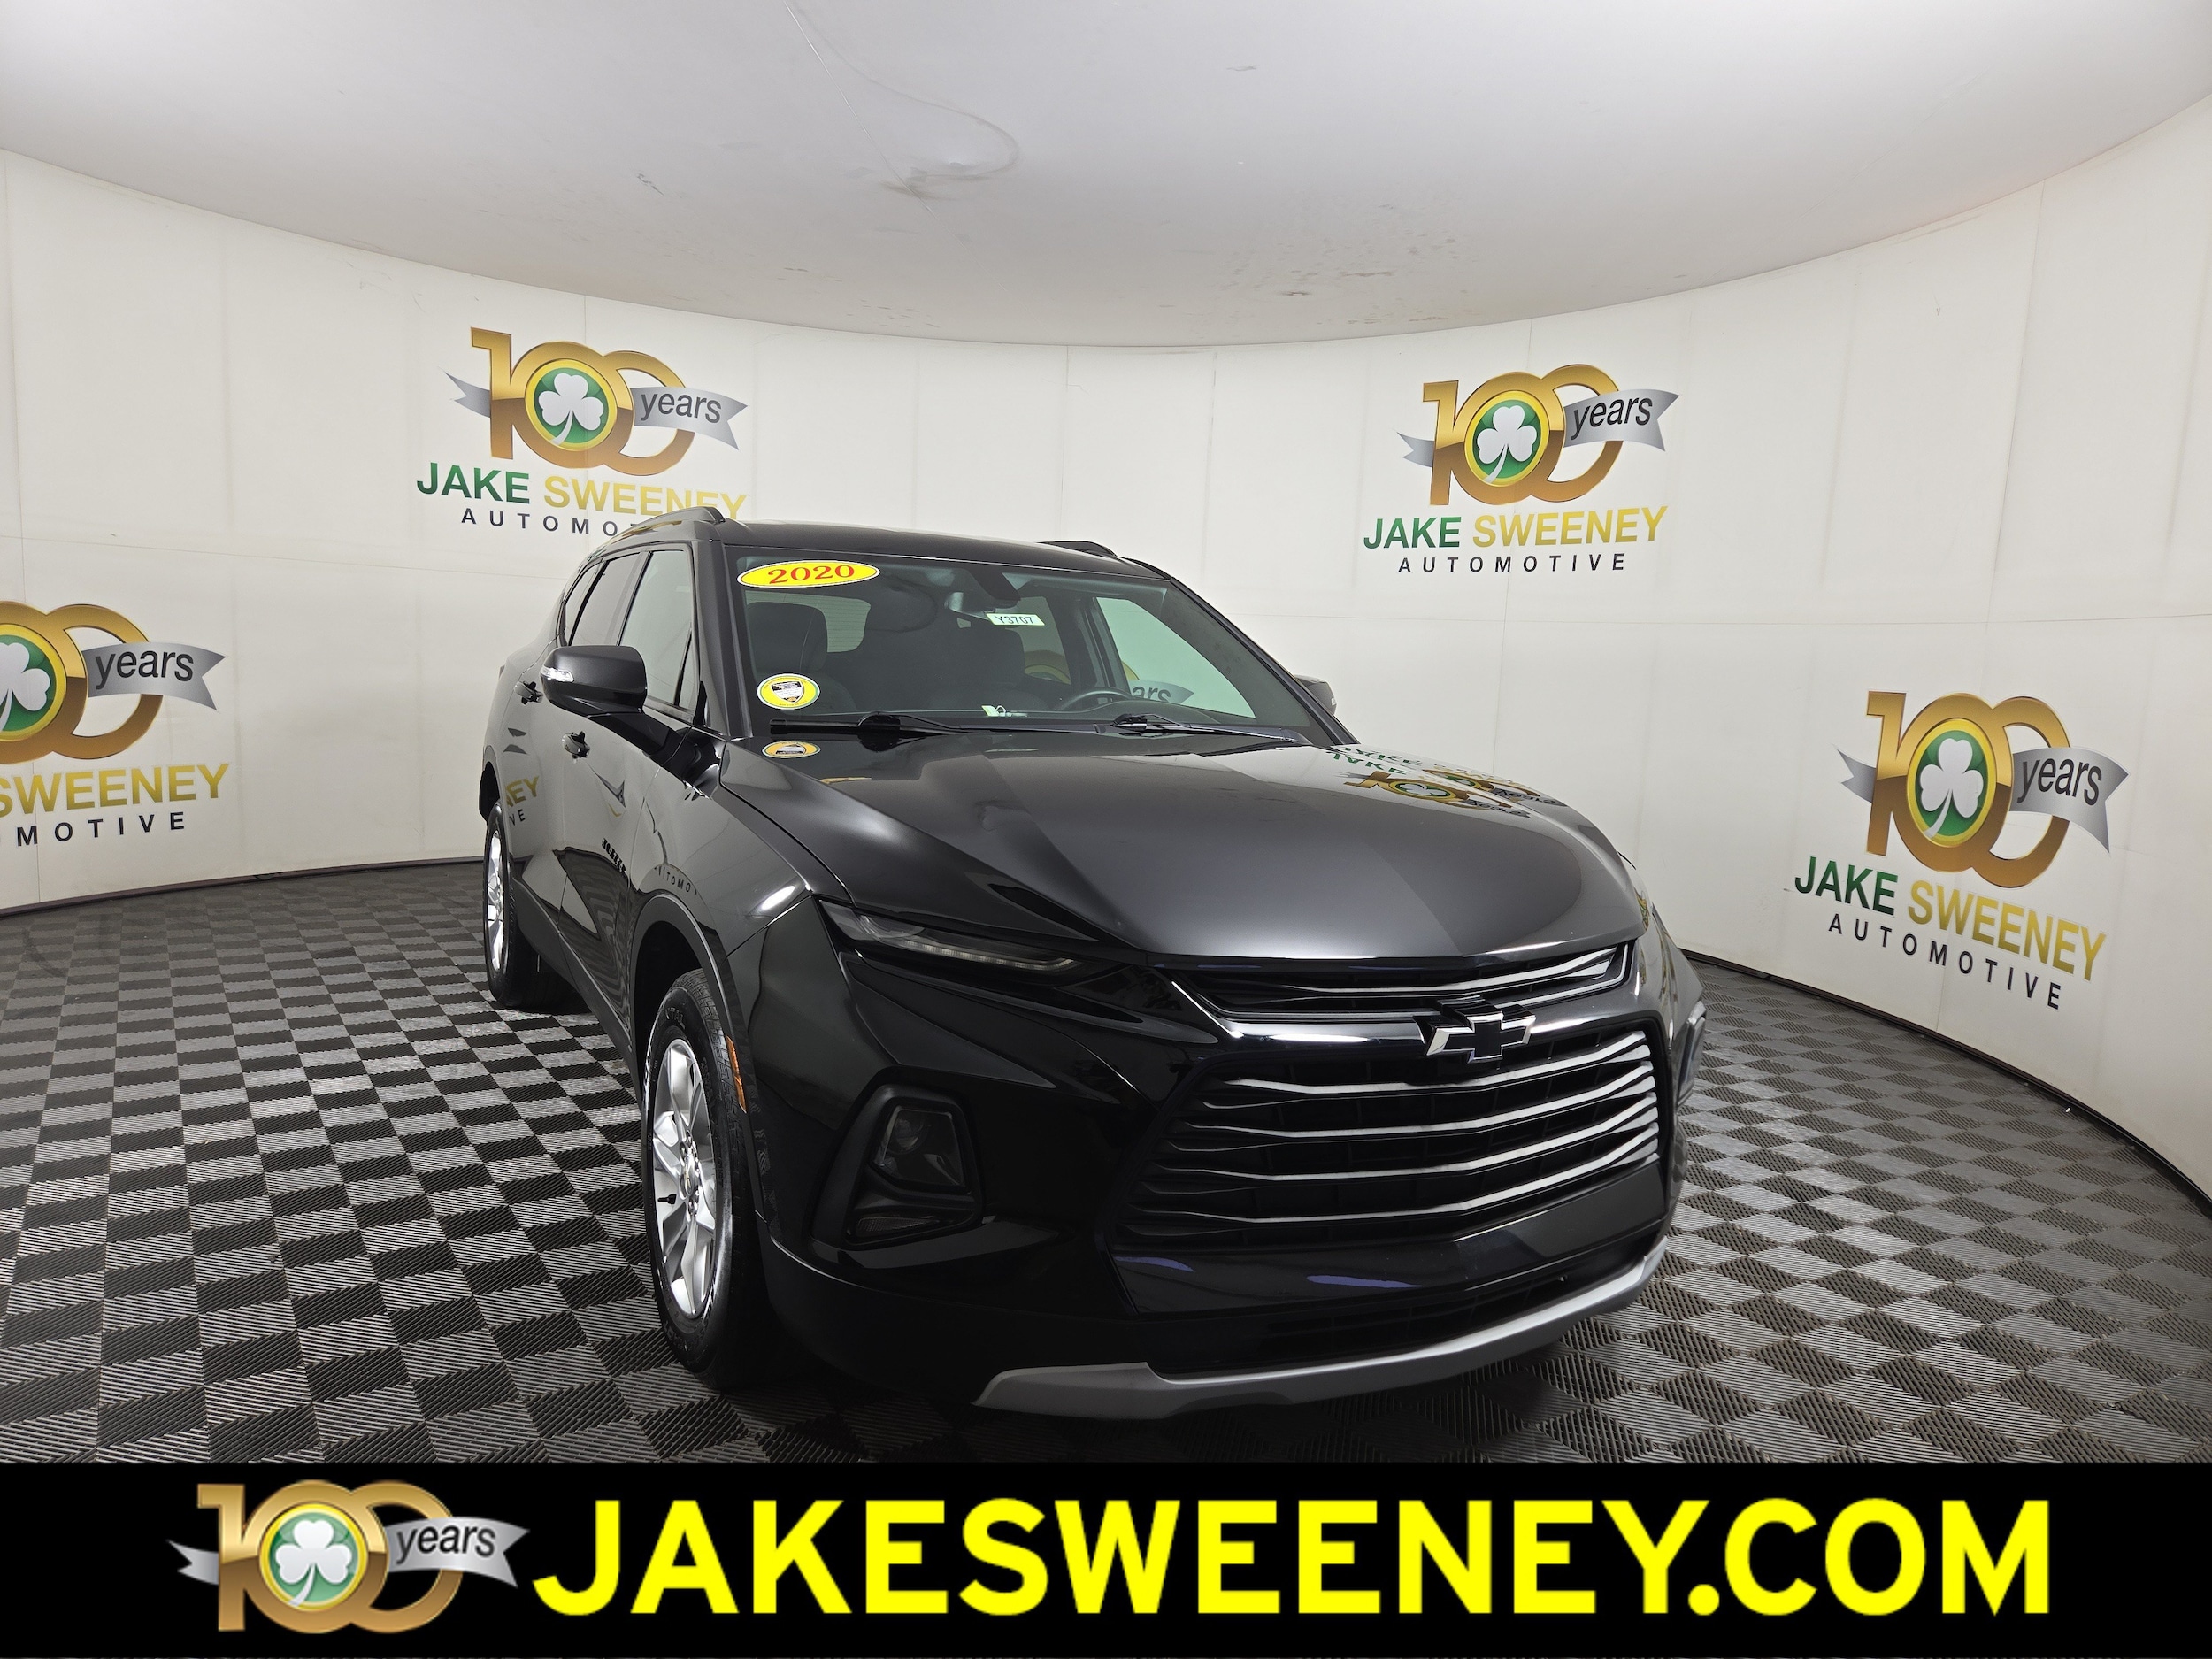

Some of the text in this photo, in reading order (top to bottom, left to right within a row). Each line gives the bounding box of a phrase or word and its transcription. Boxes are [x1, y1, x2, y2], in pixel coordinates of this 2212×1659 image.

[471, 326, 723, 476] 100 years
[1422, 364, 1654, 506] 100 years
[417, 461, 530, 505] JAKE
[461, 507, 637, 537] AUTOMO
[1363, 506, 1668, 549] JAKE SWEENEY
[767, 565, 855, 584] 2020
[1398, 553, 1625, 573] AUTOMOTIVE
[994, 615, 1034, 625] Y3707
[0, 600, 194, 766] 00 years
[1132, 685, 1171, 703] ars
[1866, 691, 2102, 888] 100 years
[17, 811, 185, 847] MOTIVE
[1794, 856, 2107, 981] JAKE SWEENEY
[1828, 913, 2062, 1010] AUTOMOTIVE
